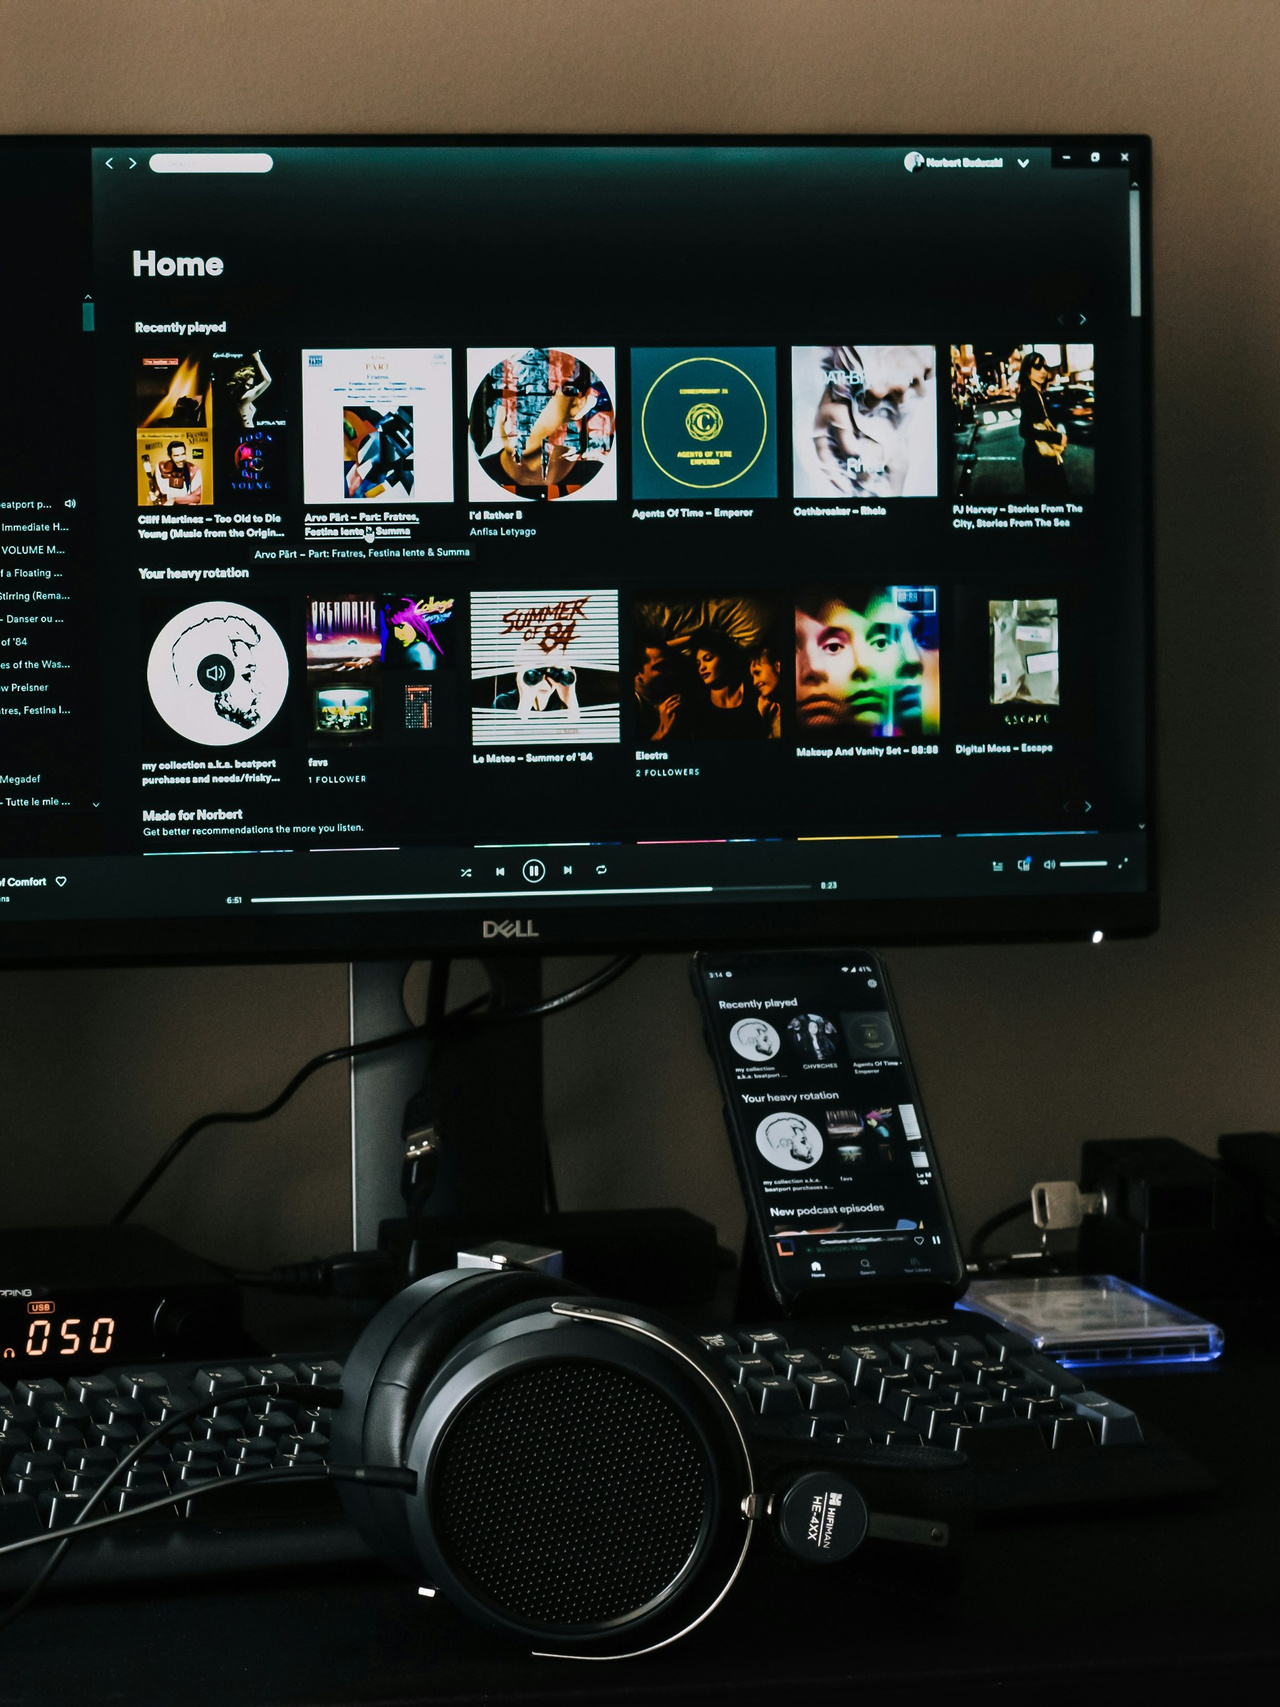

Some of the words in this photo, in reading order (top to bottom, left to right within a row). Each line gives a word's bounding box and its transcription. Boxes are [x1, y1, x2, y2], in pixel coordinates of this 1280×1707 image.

[132, 249, 225, 277] Home
[134, 321, 187, 336] Recently
[187, 320, 227, 336] played
[483, 510, 515, 520] Rather
[631, 508, 666, 521] Agents
[666, 508, 680, 518] Of
[679, 507, 705, 518] Time
[713, 507, 754, 520] Emperor
[952, 504, 965, 515] PJ
[965, 504, 999, 516] Harvey
[1007, 503, 1040, 514] Stories
[1040, 503, 1065, 514] From
[1065, 503, 1084, 514] The
[137, 514, 161, 525] Cliff
[160, 514, 205, 525] Martinez
[213, 513, 233, 524] Too
[232, 513, 252, 524] Old
[252, 514, 264, 524] to
[264, 513, 282, 524] Die
[1, 522, 51, 532] Immediate
[469, 527, 499, 537] Anfisa
[500, 526, 537, 538] Letyago
[254, 550, 277, 559] Arvo
[368, 548, 401, 558] Festina
[402, 548, 426, 557] lente
[436, 547, 471, 557] Summa
[137, 567, 167, 580] Your
[166, 567, 203, 582] heavy
[202, 566, 250, 579] rotation
[499, 595, 592, 634] SUMMER
[523, 625, 544, 642] OF
[538, 619, 582, 656] 84
[635, 750, 669, 761] Electra
[796, 747, 834, 759] Makeup
[834, 746, 855, 757] And
[854, 746, 885, 758] Vanity
[885, 745, 902, 756] Set
[955, 743, 986, 756] Digital
[1020, 742, 1054, 754] Escape
[307, 757, 329, 767] favs
[472, 754, 485, 764] Le
[485, 753, 516, 764] Matos
[525, 752, 565, 763] Summer
[565, 751, 577, 762] of
[141, 762, 158, 773] my
[158, 759, 207, 771] collection
[234, 759, 277, 771] beatport
[0, 774, 41, 786] Megadef
[315, 774, 367, 784] FOLLOWER
[142, 809, 177, 822] Made
[177, 809, 196, 821] for
[196, 808, 244, 821] Norbert
[142, 827, 161, 837] Get
[162, 827, 191, 836] better
[192, 825, 274, 836] recommendations
[275, 824, 291, 834] the
[292, 825, 317, 833] more
[318, 825, 335, 835] you
[337, 823, 364, 832] listen.
[6, 876, 47, 887] Comfort
[483, 920, 539, 938] DELL
[718, 999, 763, 1010] Recently
[764, 997, 799, 1010] played
[741, 1093, 766, 1104] Your
[766, 1093, 798, 1103] heavy
[799, 1090, 840, 1101] rotation
[769, 1207, 795, 1217] New
[796, 1205, 839, 1218] podcast
[839, 1202, 885, 1215] episodes
[31, 1303, 50, 1312] USB
[851, 1318, 949, 1333] lenovo
[26, 1318, 114, 1355] 050
[807, 1495, 823, 1541] HE-4XX
[823, 1508, 837, 1549] HIFIMAN
